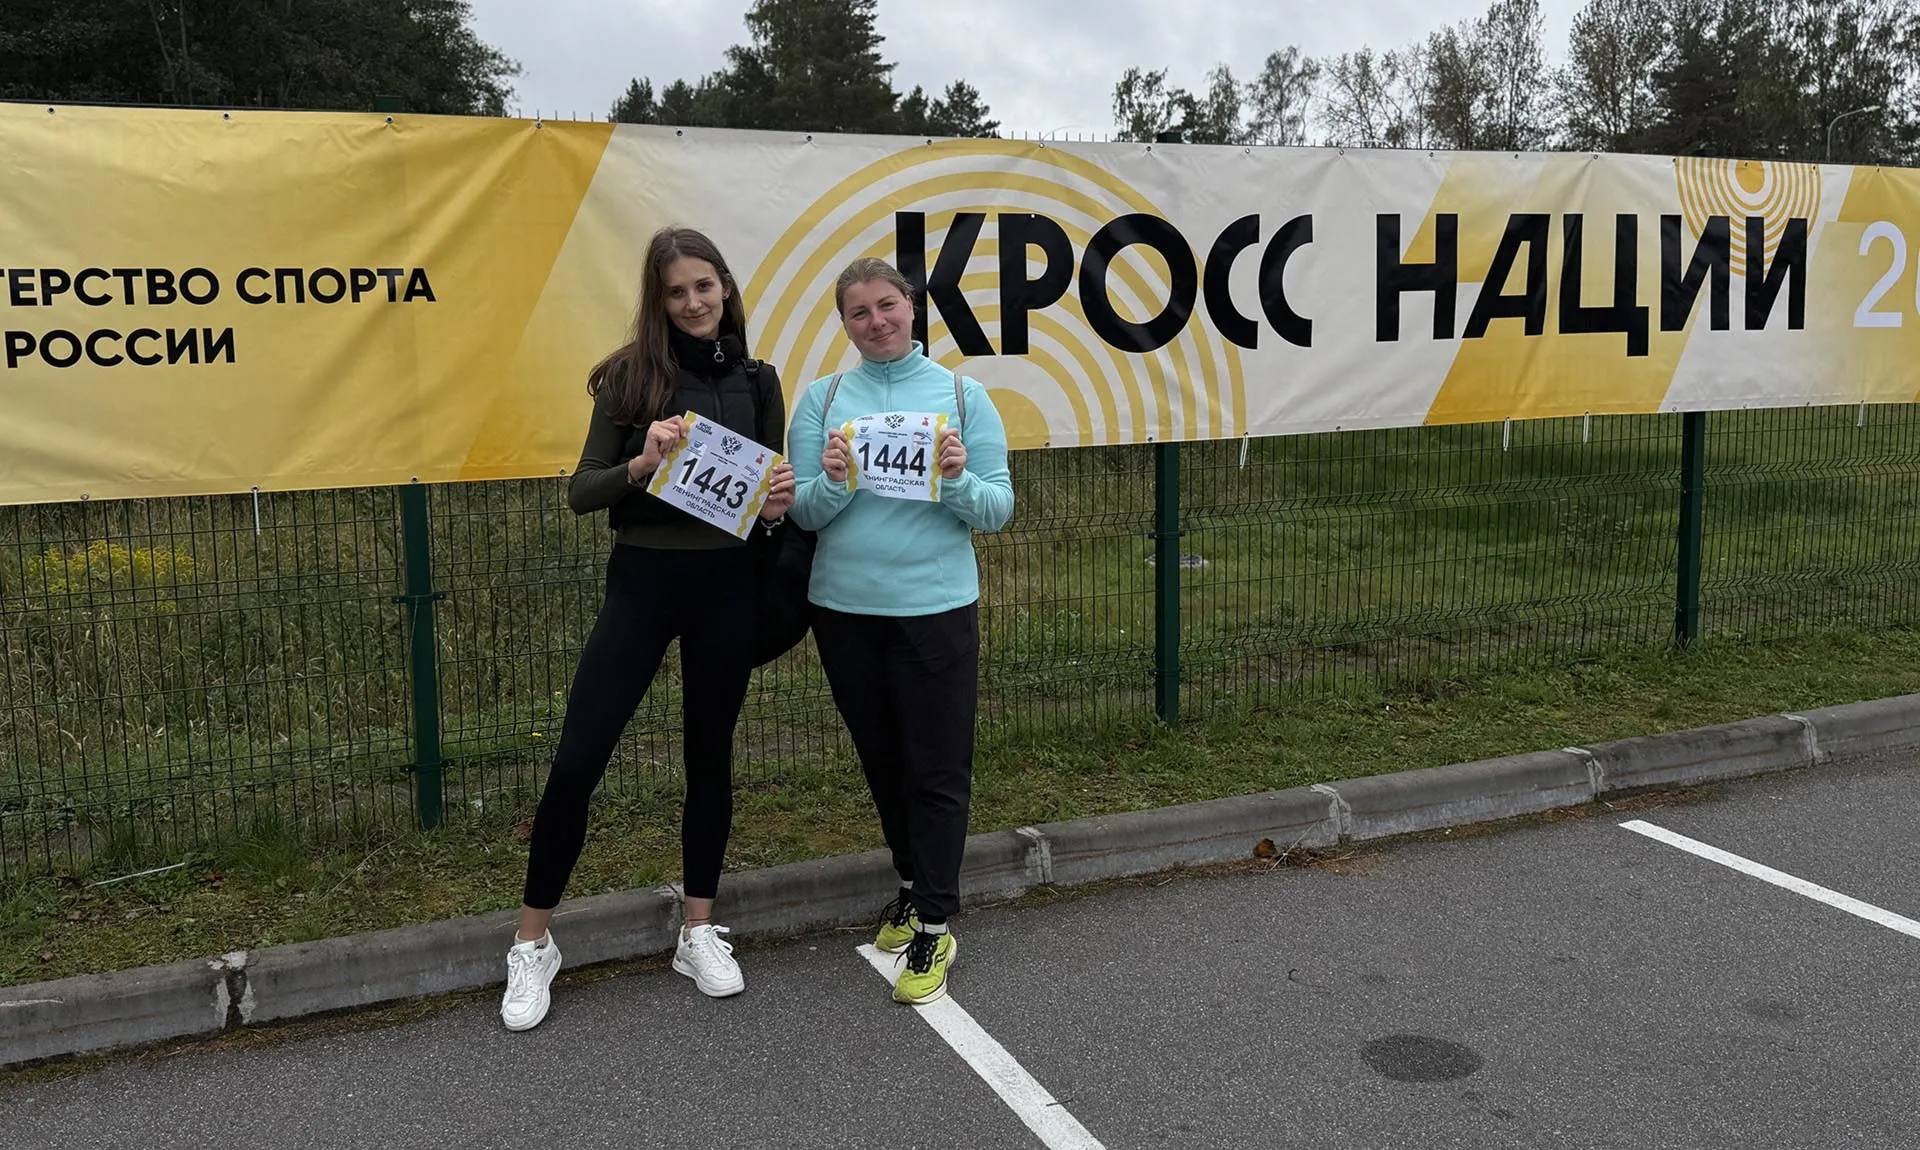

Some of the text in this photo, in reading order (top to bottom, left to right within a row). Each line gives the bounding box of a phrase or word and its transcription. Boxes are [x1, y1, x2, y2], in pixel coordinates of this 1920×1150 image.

[235, 266, 437, 304] СПОРТА
[896, 211, 1920, 357] КРОСС НАЦИИ 2
[4, 327, 236, 369] РОССИИ
[858, 442, 926, 477] 1444
[681, 457, 748, 509] 1443
[875, 484, 906, 493] ОБЛАСТЬ
[672, 485, 737, 519] ЛЕНИНГРАДСКАЯ
[686, 500, 716, 519] ОБЛАСТЬ
